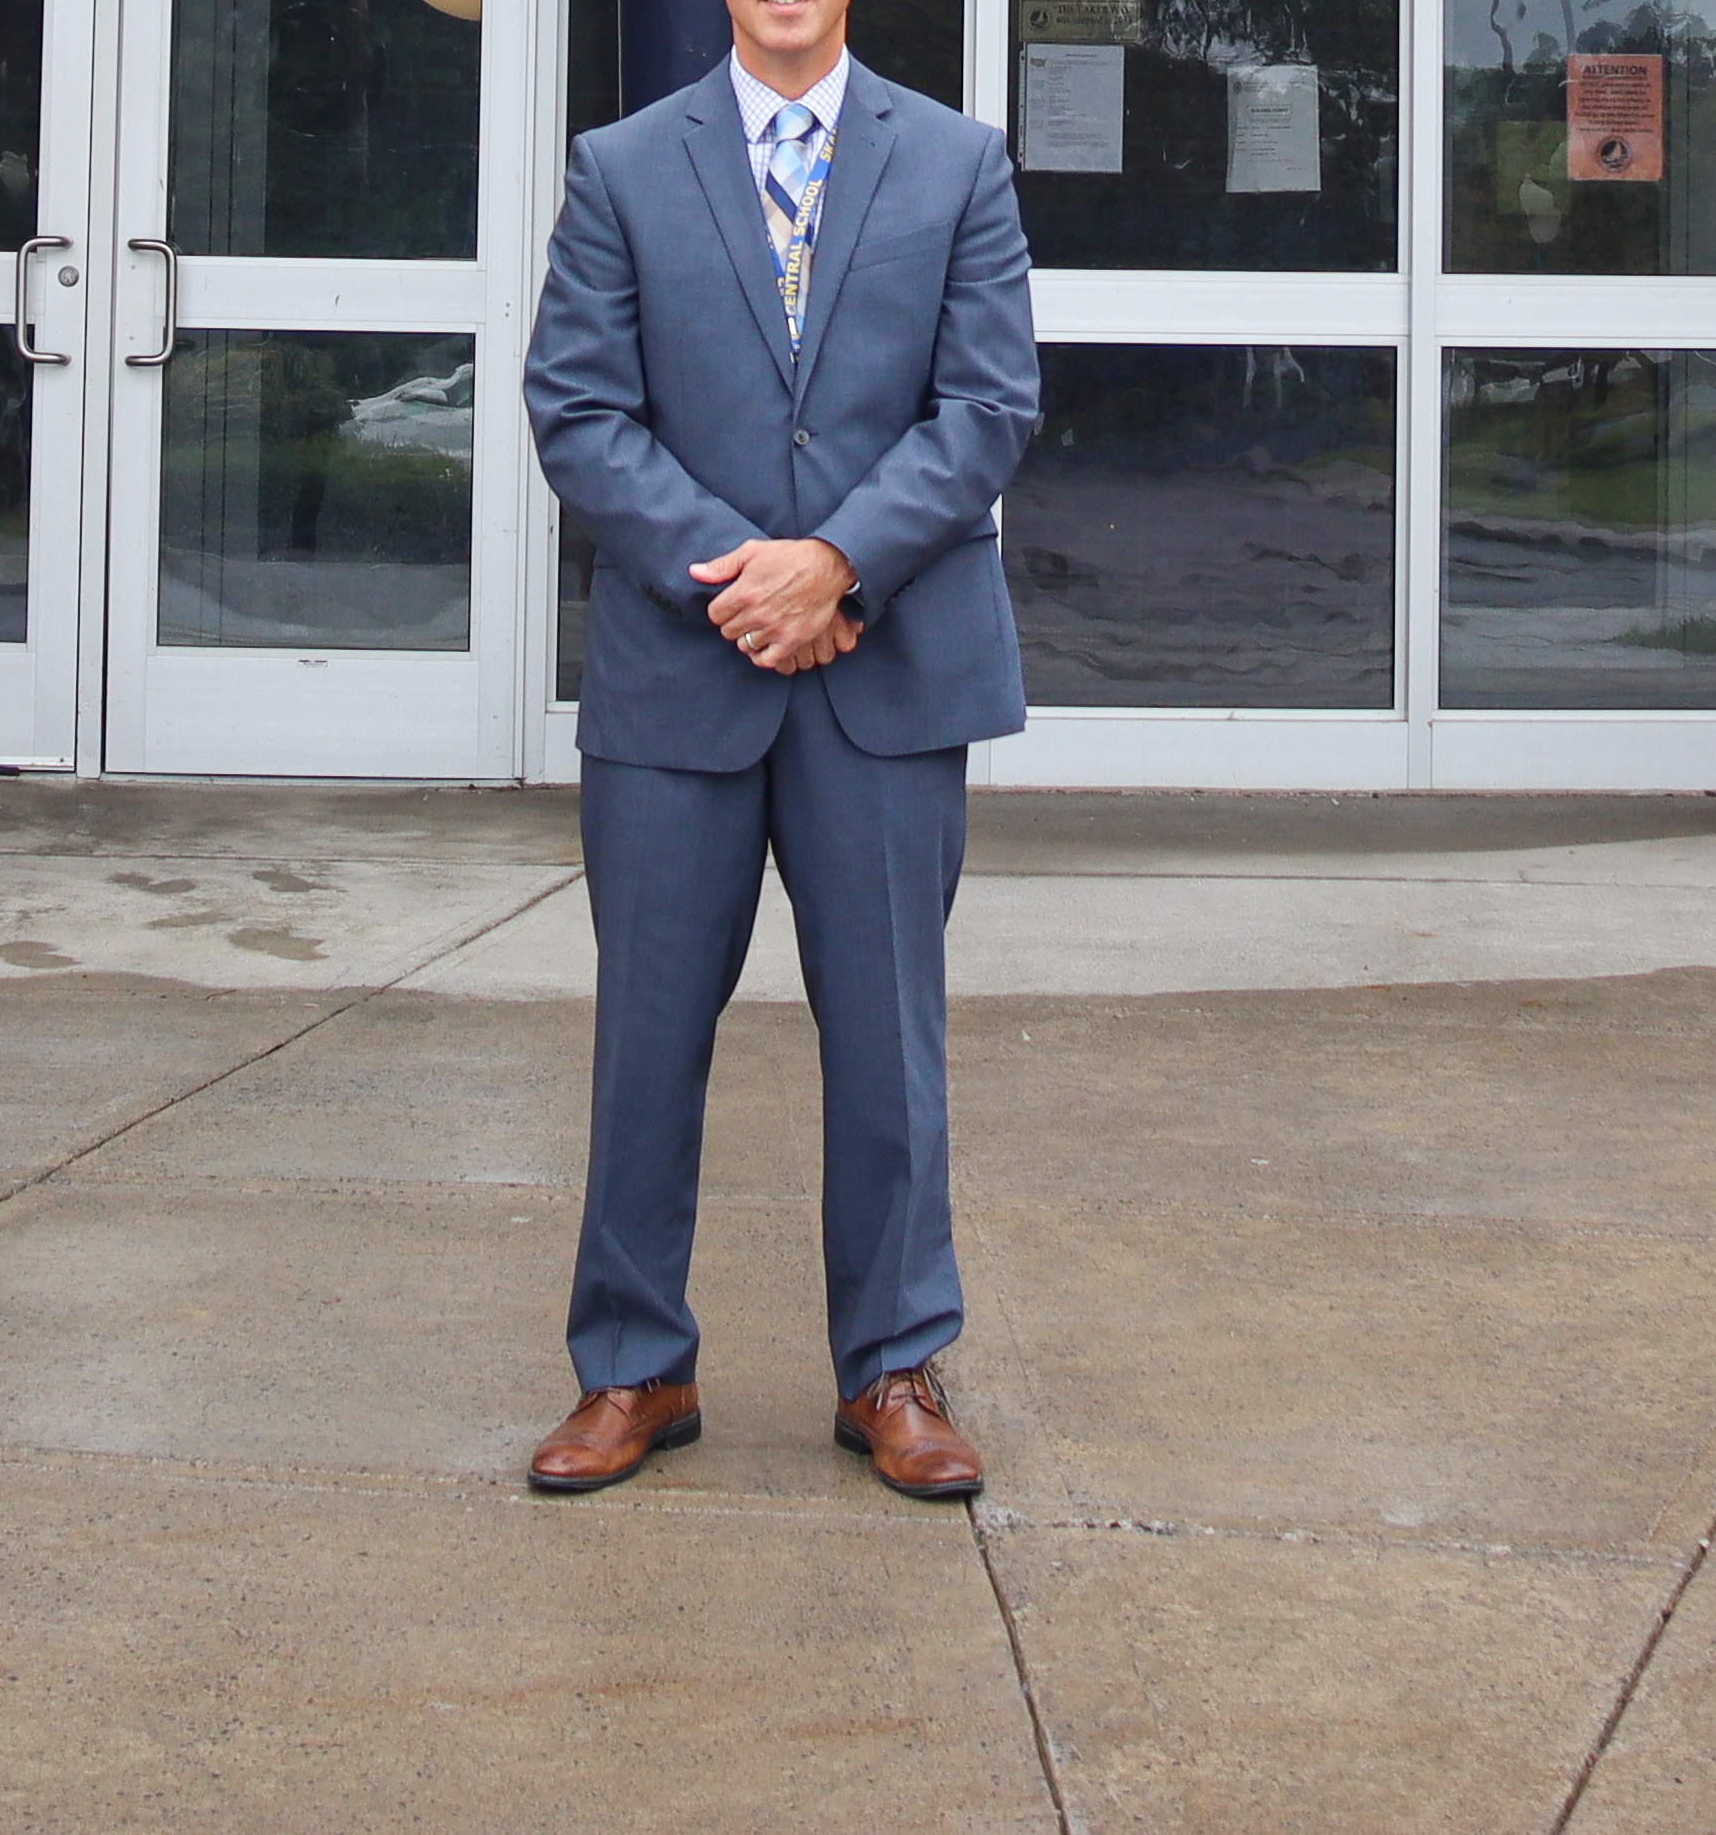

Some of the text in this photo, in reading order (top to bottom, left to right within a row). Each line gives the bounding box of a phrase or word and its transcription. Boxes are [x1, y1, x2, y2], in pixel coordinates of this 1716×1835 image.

[1583, 65, 1647, 75] ATTENTION
[793, 179, 823, 237] SCHOOL
[784, 240, 804, 316] CENTRAL
